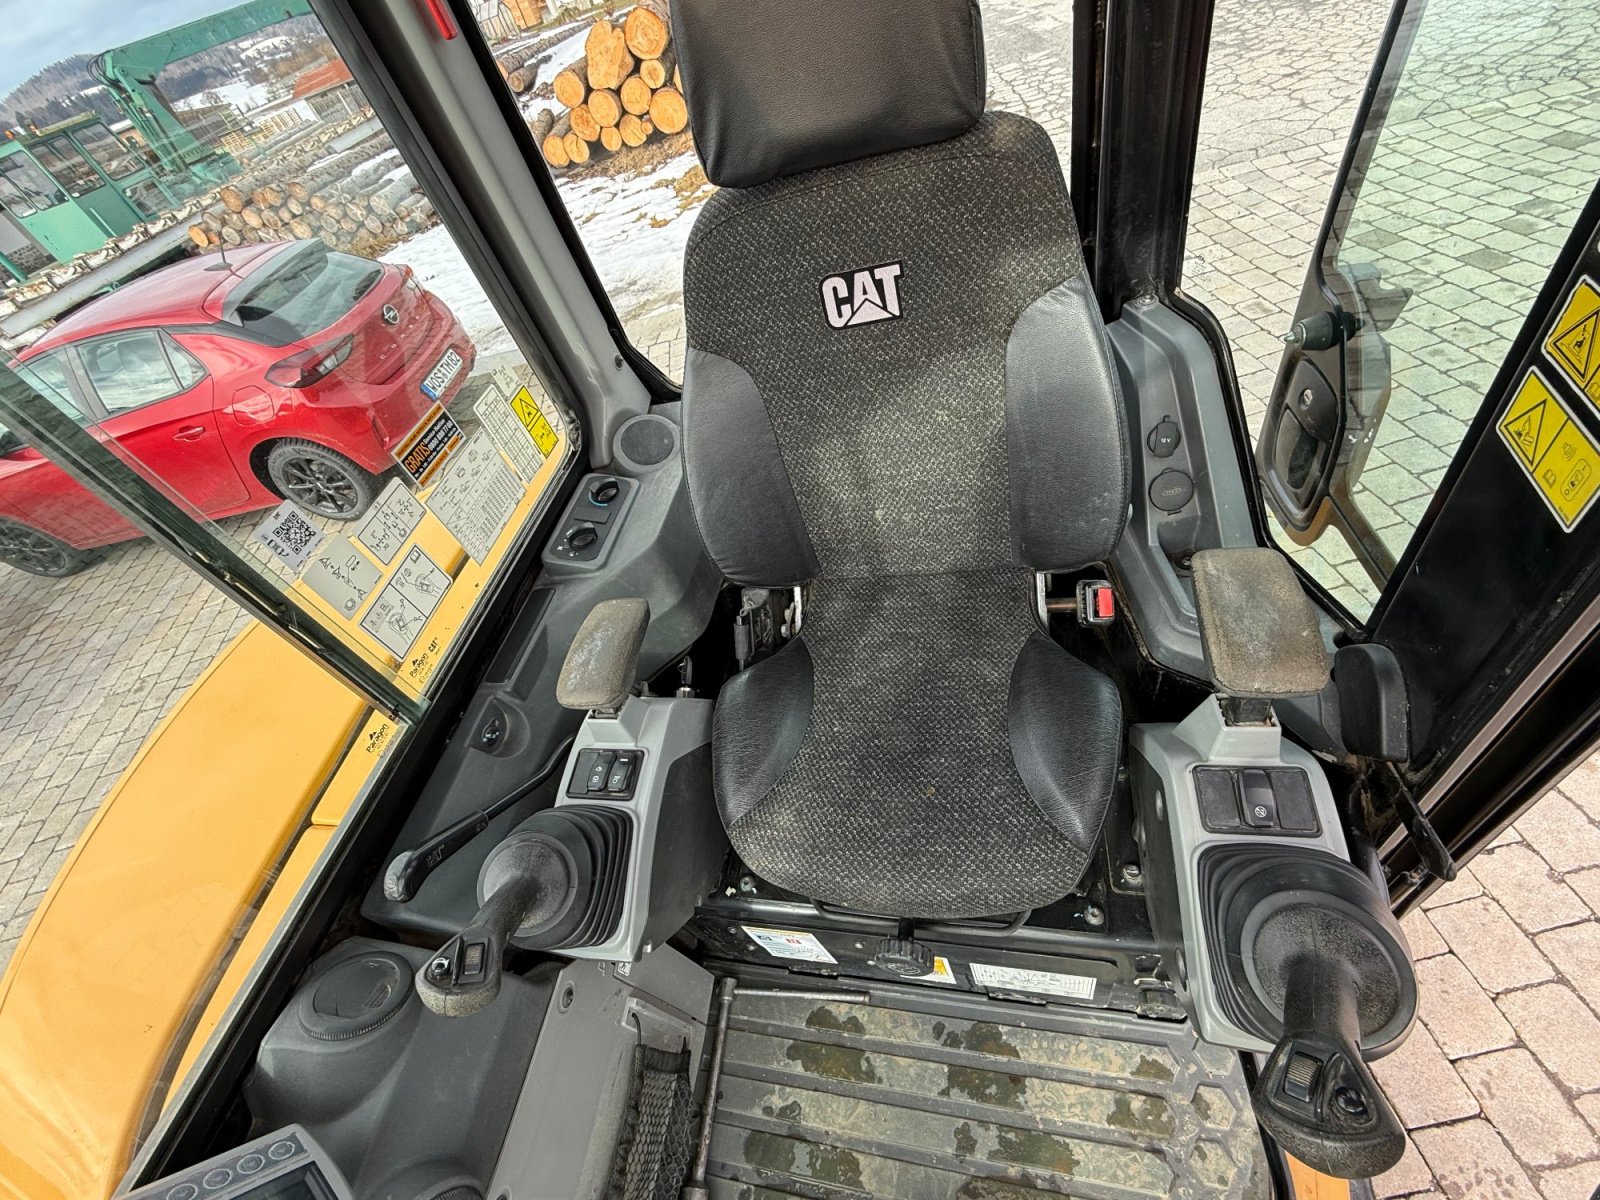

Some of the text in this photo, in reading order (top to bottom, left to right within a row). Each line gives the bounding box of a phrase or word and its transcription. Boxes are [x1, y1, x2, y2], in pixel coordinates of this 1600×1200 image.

[820, 262, 902, 329] CAT
[425, 371, 445, 392] WOS
[404, 442, 431, 473] GRATIS
[409, 652, 428, 677] Paragon
[366, 723, 388, 753] Paragon
